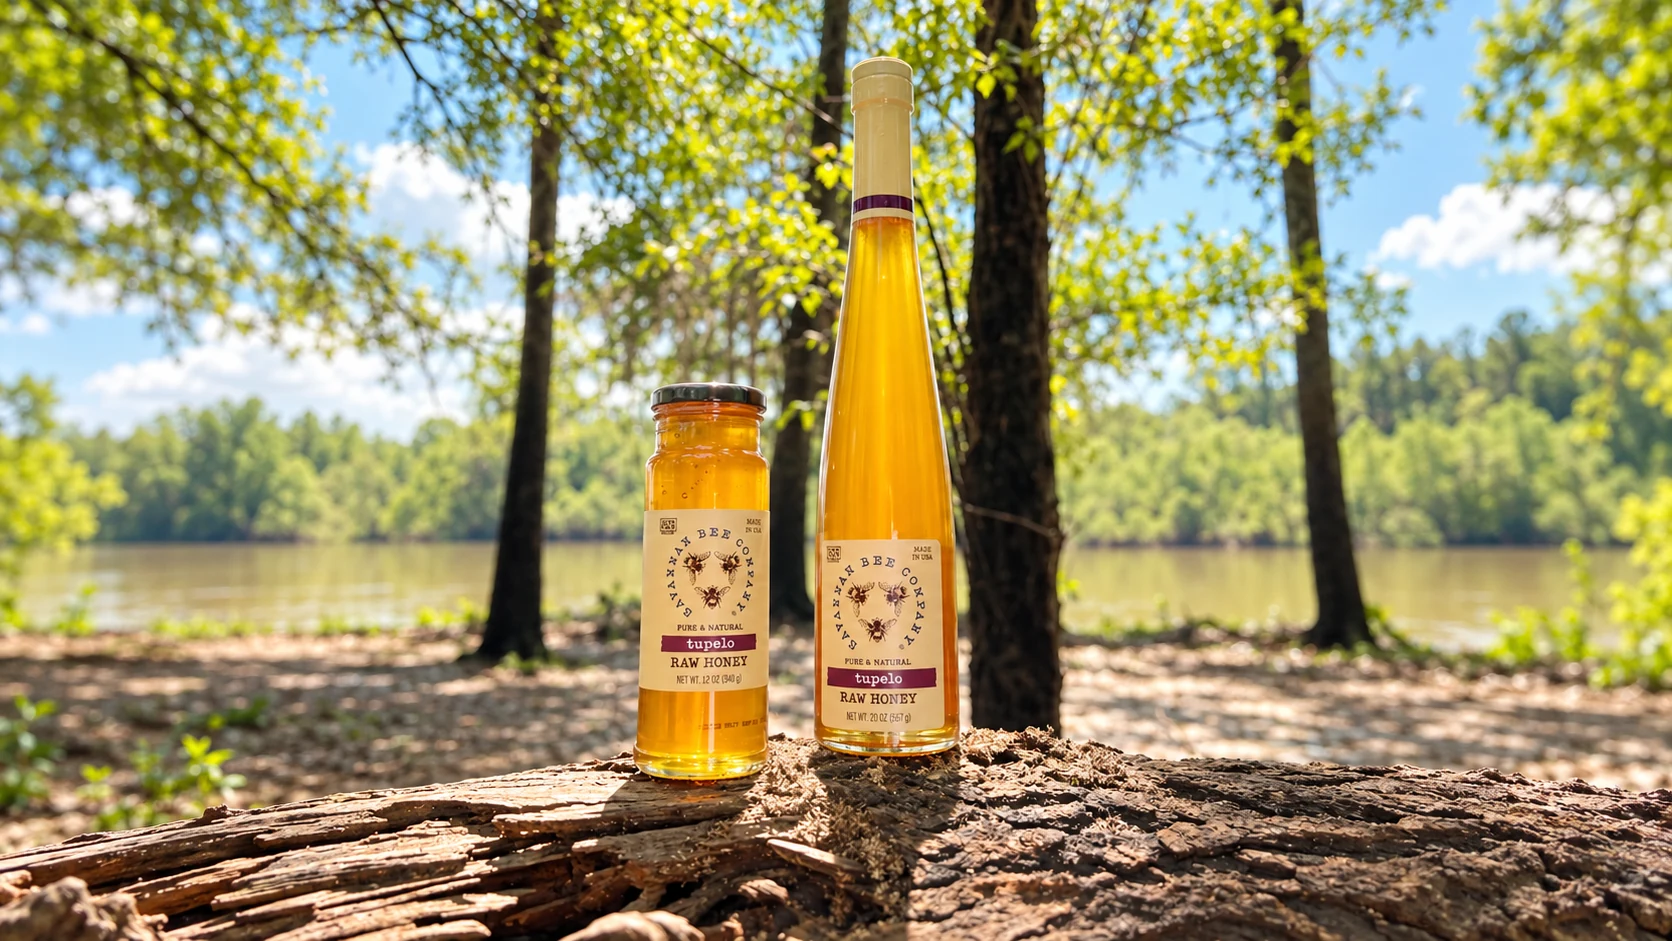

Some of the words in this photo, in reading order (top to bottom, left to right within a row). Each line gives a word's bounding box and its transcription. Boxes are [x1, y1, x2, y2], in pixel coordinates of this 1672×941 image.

[697, 527, 731, 539] BEE
[860, 555, 895, 567] BEE
[687, 637, 735, 651] tupelo
[670, 657, 700, 668] RAW
[703, 656, 748, 668] HONEY
[676, 675, 688, 684] NET
[690, 675, 701, 684] WT.
[702, 675, 710, 684] 12
[855, 672, 903, 687] tupelo
[840, 691, 866, 704] RAW
[870, 693, 917, 704] HONEY
[846, 711, 857, 721] NET
[870, 712, 878, 722] 20
[879, 712, 888, 722] OZ
